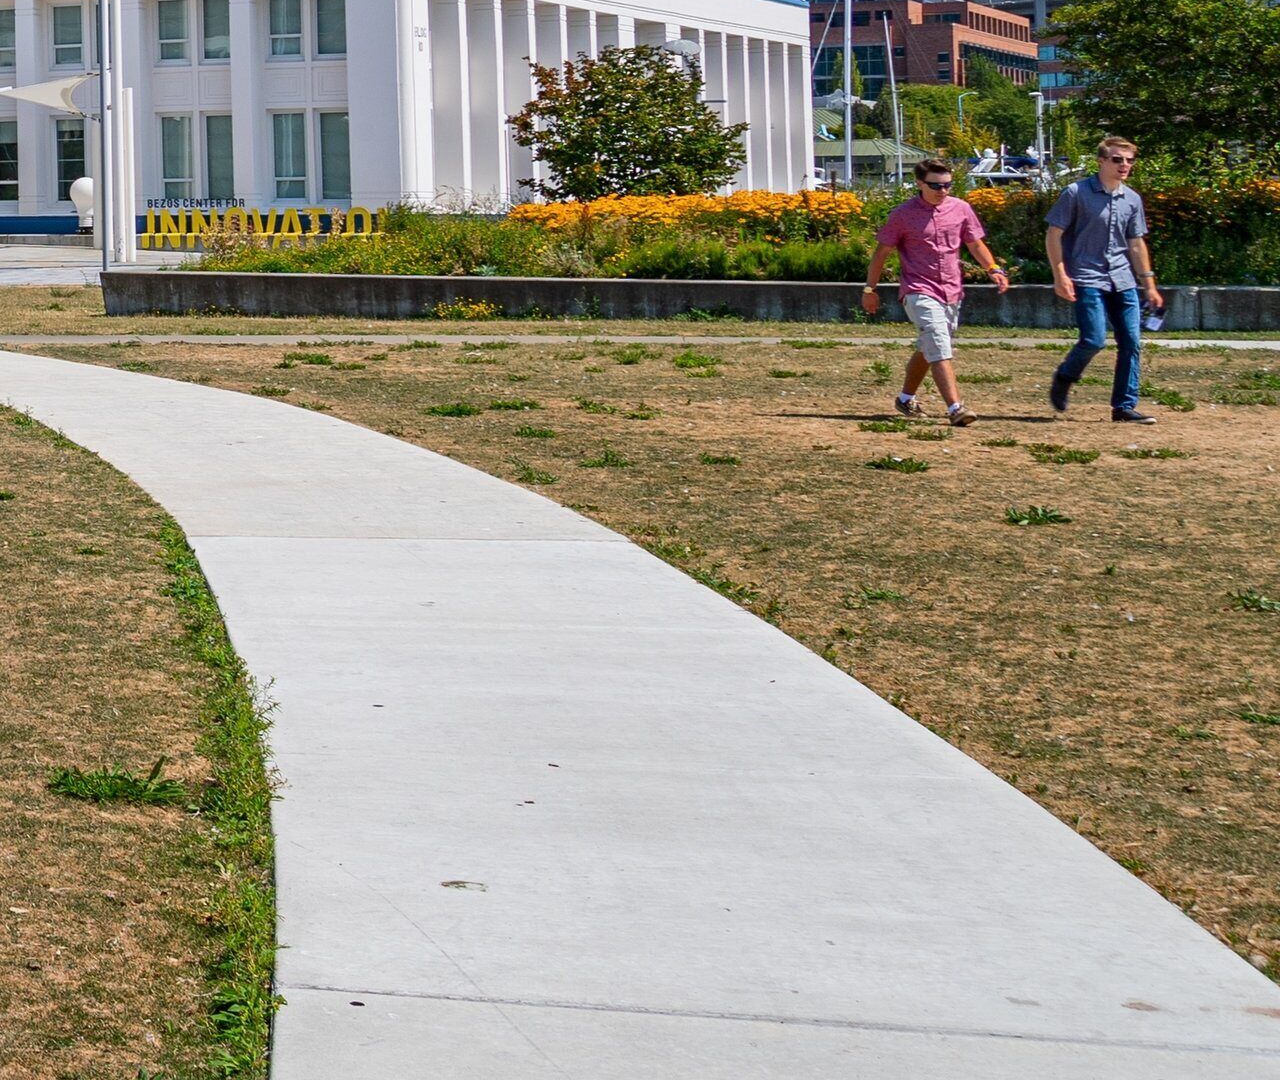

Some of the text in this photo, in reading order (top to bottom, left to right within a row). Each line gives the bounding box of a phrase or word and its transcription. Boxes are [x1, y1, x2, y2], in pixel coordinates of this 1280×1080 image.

[147, 198, 245, 208] BEZOS CENTER FOR
[141, 206, 389, 249] INNOVATO
